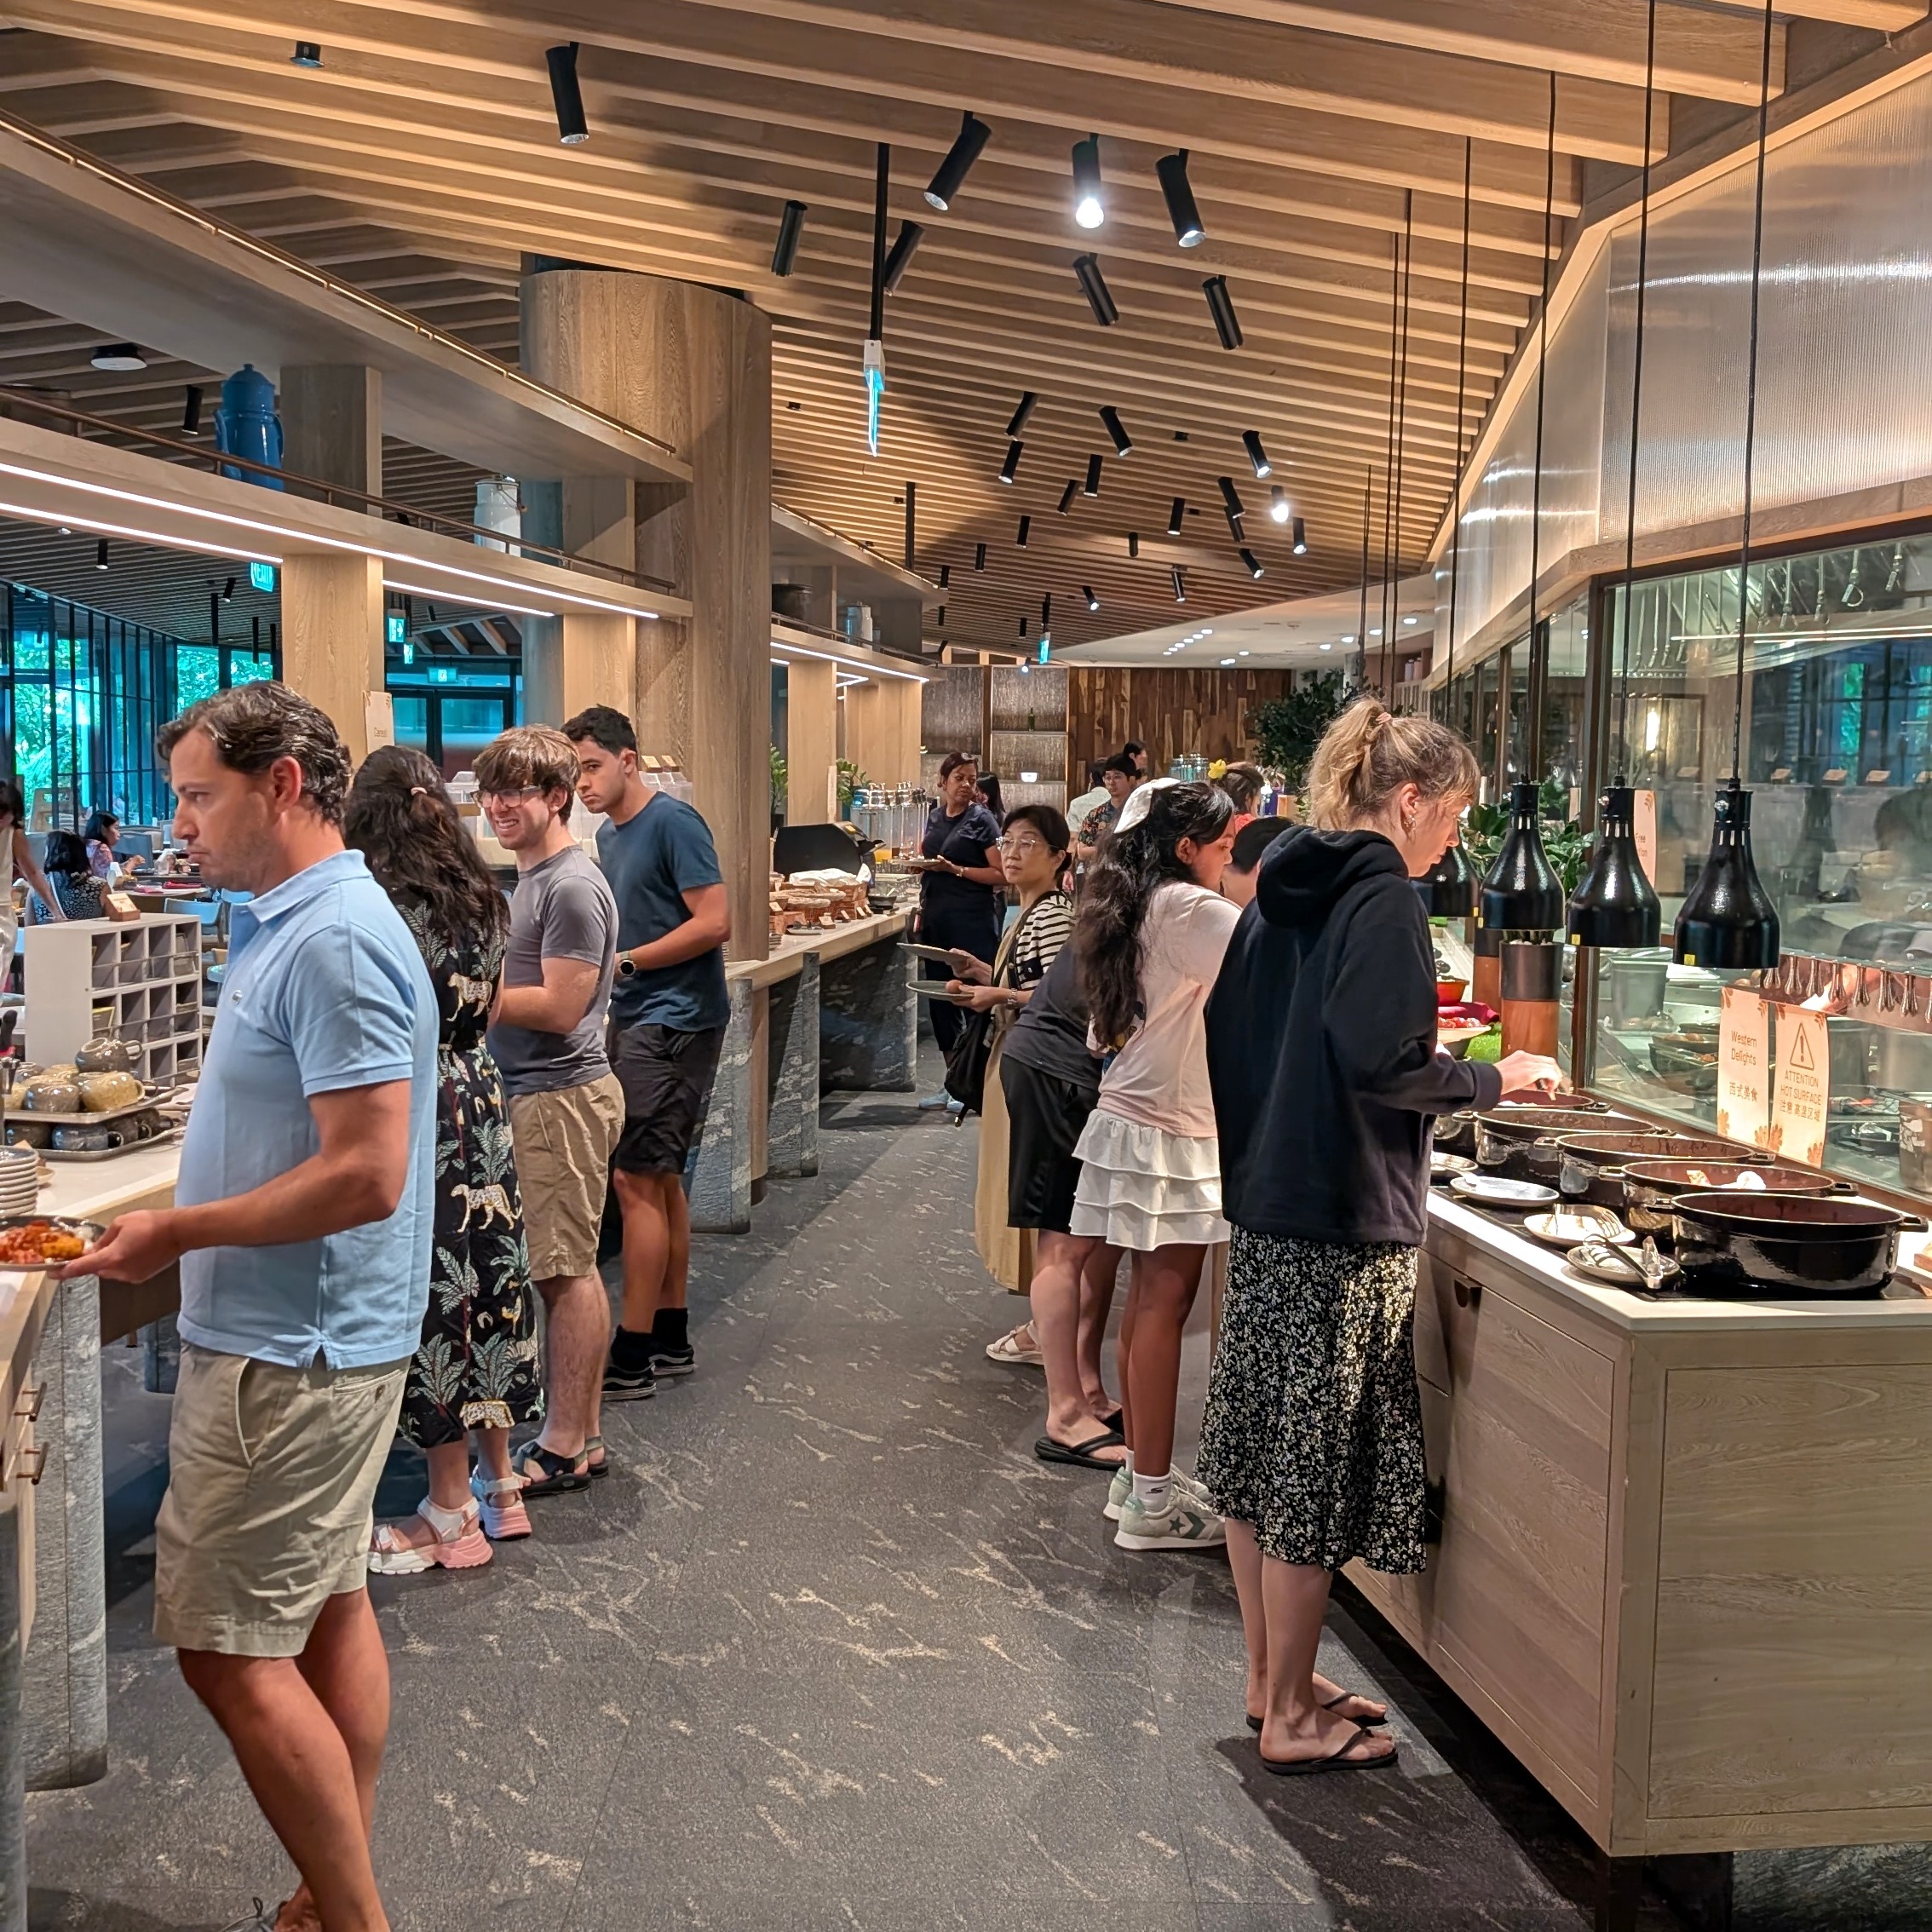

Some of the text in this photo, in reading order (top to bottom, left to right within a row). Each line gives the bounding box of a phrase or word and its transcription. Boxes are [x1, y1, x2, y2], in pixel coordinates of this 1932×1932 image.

[1731, 1029, 1757, 1048] Western
[1731, 1048, 1757, 1066] Delights
[1785, 1069, 1819, 1088] ATTENTION
[1780, 1084, 1822, 1106] HOT SURFACE
